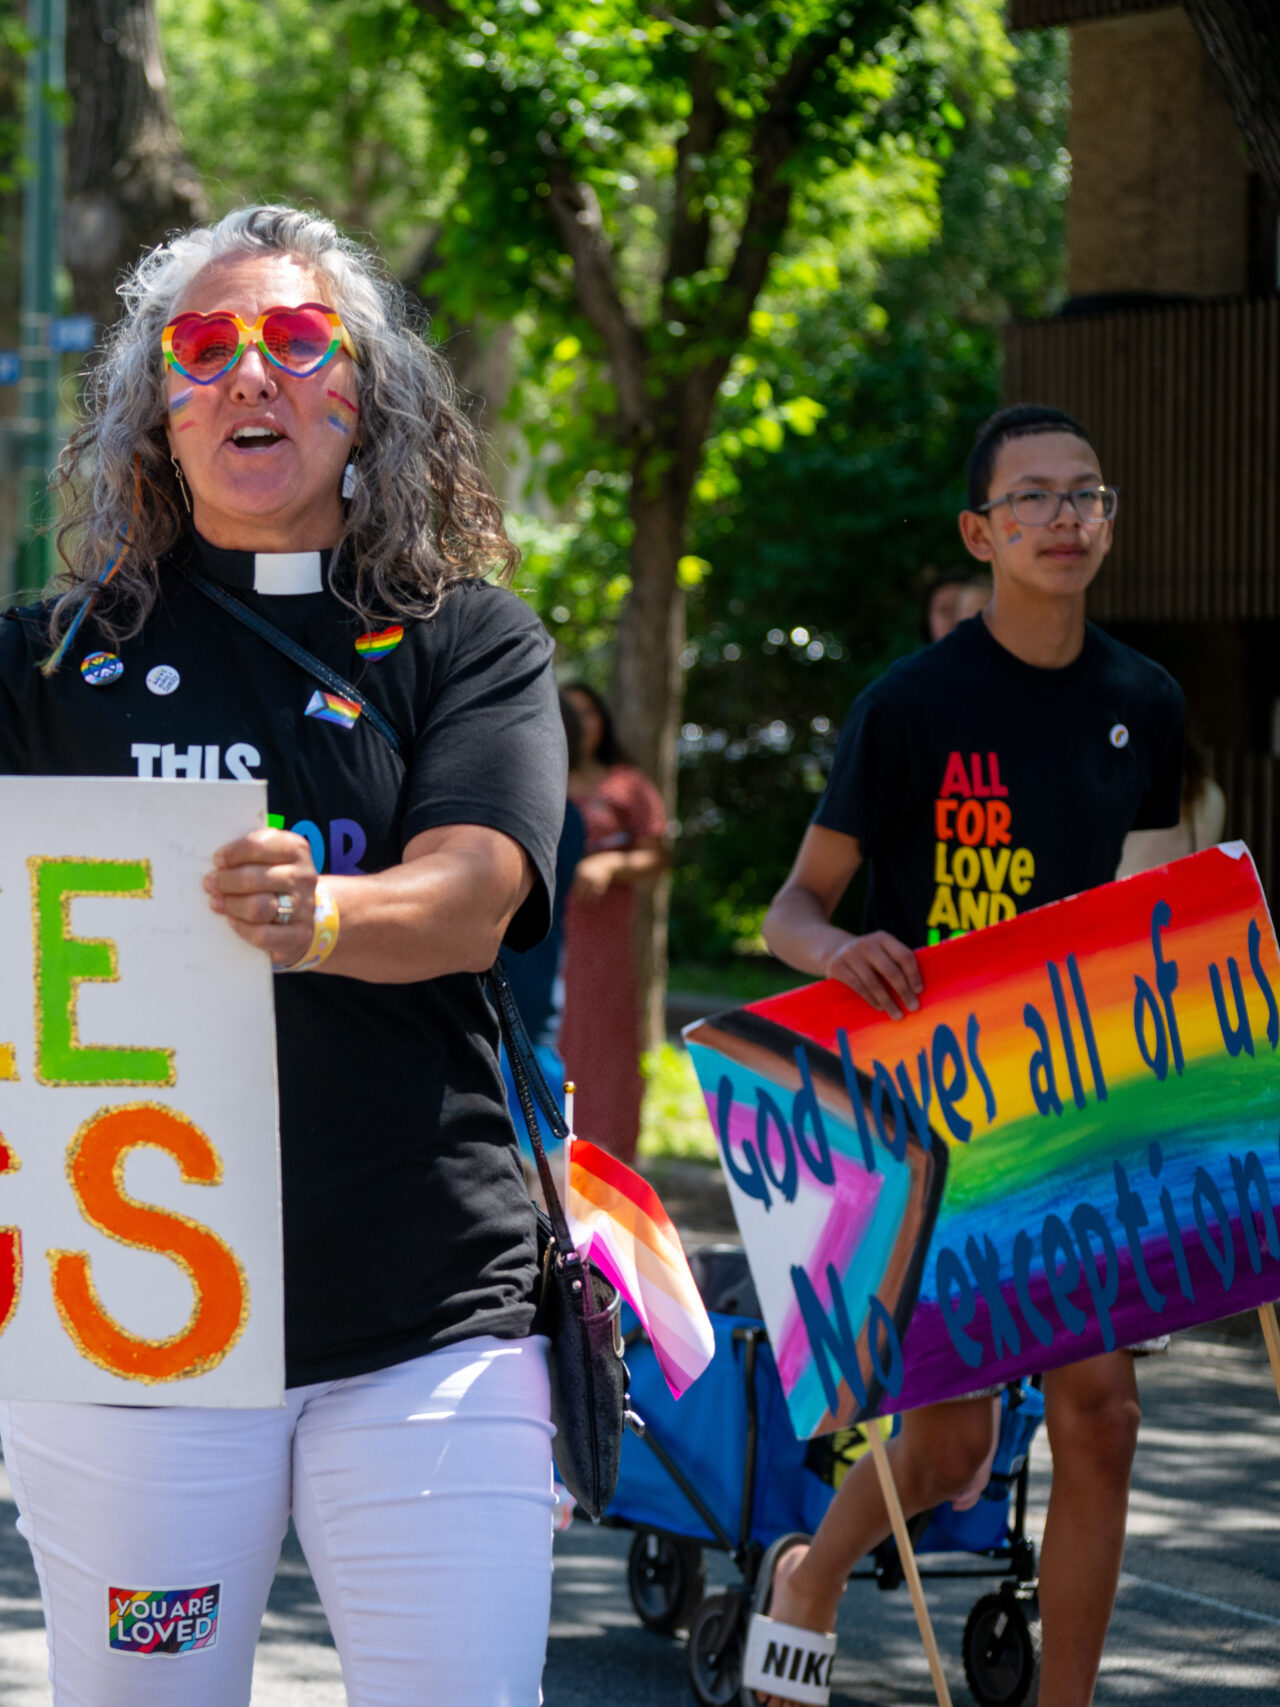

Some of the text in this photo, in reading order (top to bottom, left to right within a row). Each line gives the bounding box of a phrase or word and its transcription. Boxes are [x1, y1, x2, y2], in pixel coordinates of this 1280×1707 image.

[130, 742, 262, 782] THIS
[939, 751, 1009, 798] ALL
[935, 799, 1012, 847] FOR
[926, 885, 1017, 931] AND
[718, 899, 1279, 1212] God loves all of us
[790, 1262, 903, 1418] No
[115, 1594, 214, 1619] YOU ARE
[118, 1616, 212, 1645] LOVED
